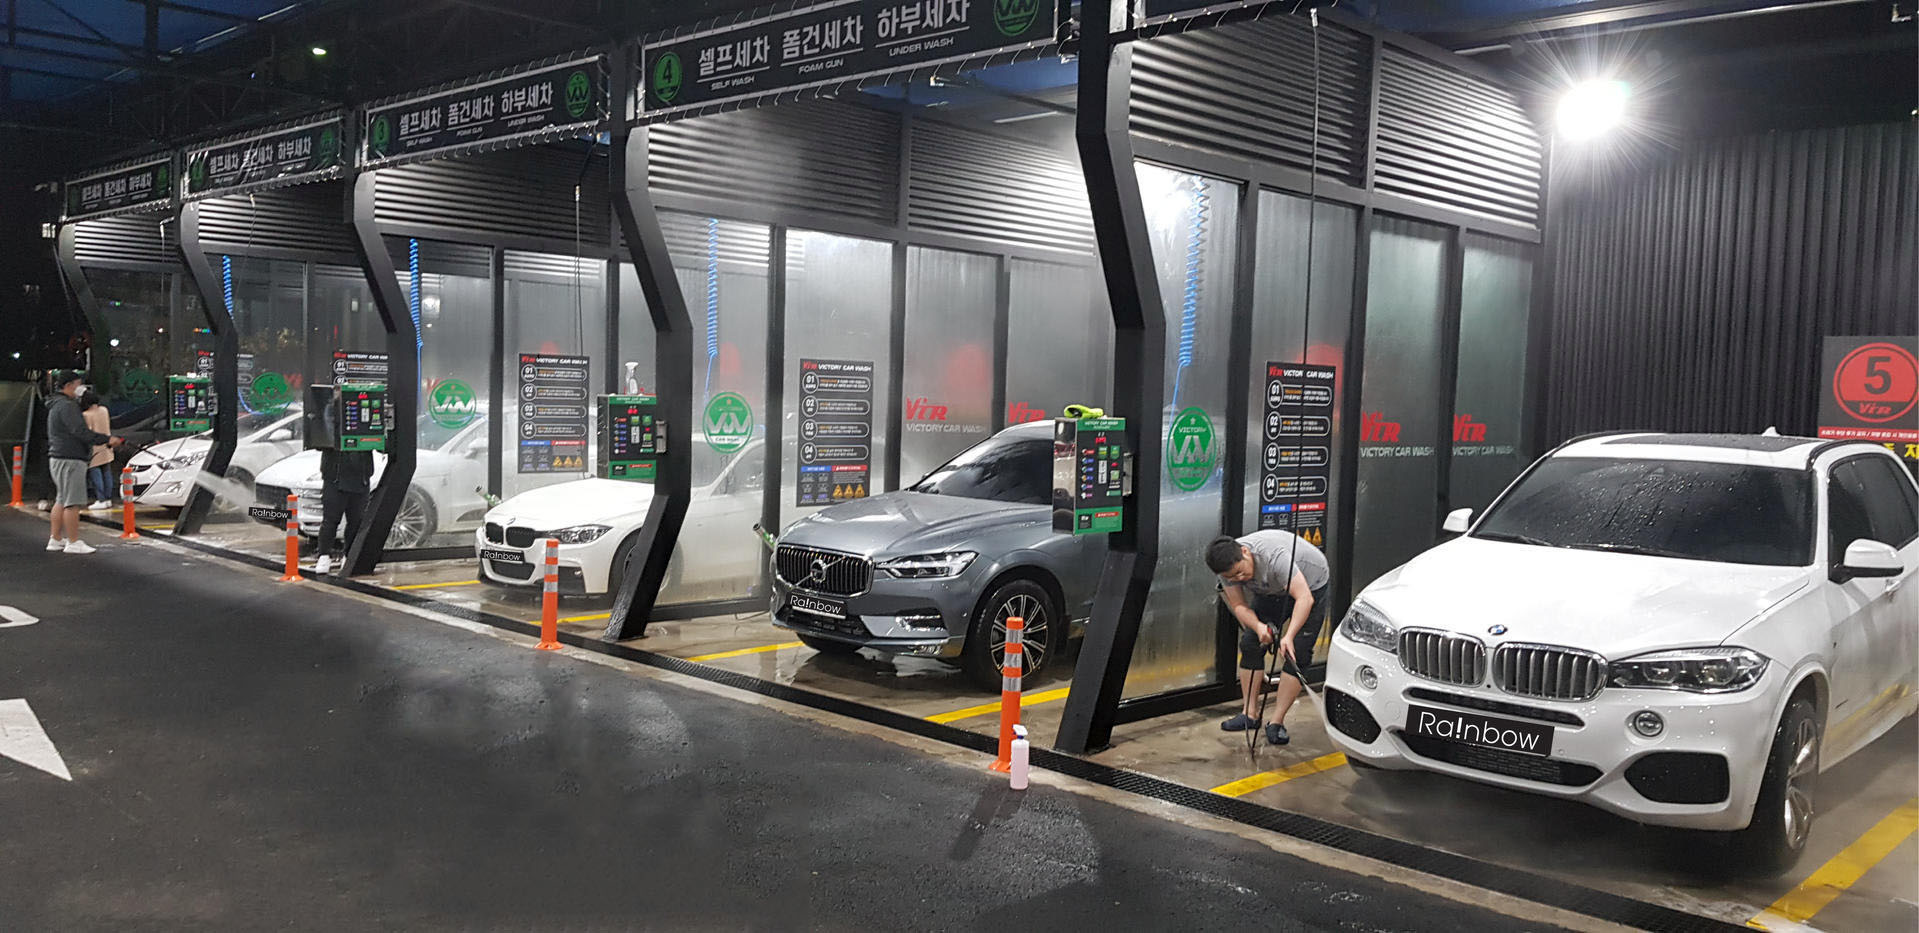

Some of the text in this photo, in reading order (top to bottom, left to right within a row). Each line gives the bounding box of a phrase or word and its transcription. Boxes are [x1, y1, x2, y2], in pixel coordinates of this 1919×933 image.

[698, 0, 970, 77] 셀프세차 폼건세차 하부세차
[889, 37, 954, 57] UNDER WASH
[663, 59, 673, 83] 4
[798, 58, 844, 75] FOAM GUN
[711, 76, 755, 91] SELF WASH
[399, 81, 553, 136] 셀프세차 폼건세차 하부세차
[278, 136, 312, 160] 하부세차
[806, 375, 815, 383] 01
[1864, 356, 1892, 395] 5
[1271, 384, 1280, 395] 01
[806, 399, 814, 407] 02
[805, 422, 814, 430] 03
[1270, 415, 1278, 426] 02
[906, 423, 944, 433] VICTORY
[944, 423, 960, 433] CAR
[804, 445, 813, 454] 04
[1268, 447, 1277, 457] 03
[1360, 445, 1435, 458] VICTORY CAR WASH
[1452, 446, 1480, 456] VICTORY
[1481, 446, 1495, 455] CAR
[1418, 711, 1540, 750] Ra!nbow
